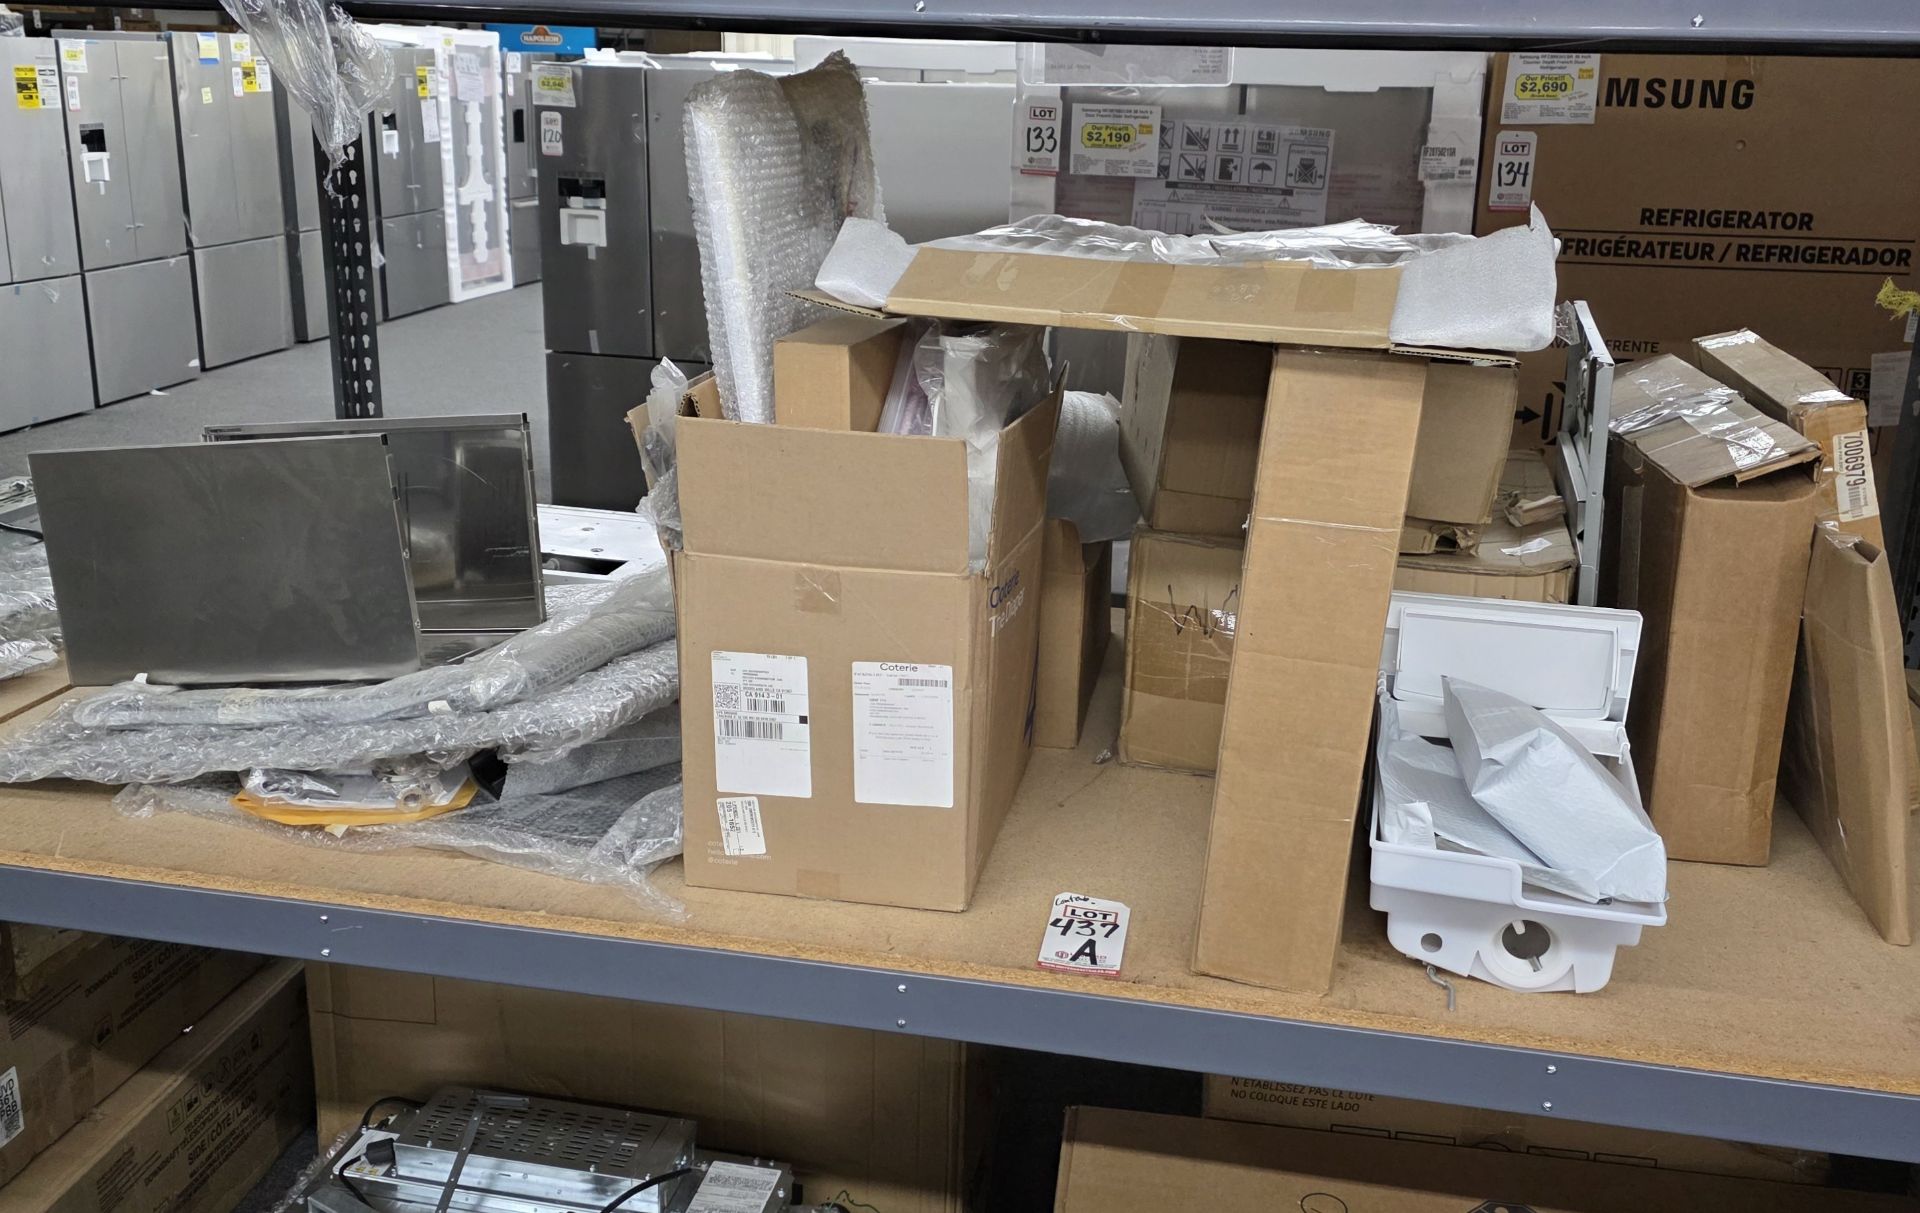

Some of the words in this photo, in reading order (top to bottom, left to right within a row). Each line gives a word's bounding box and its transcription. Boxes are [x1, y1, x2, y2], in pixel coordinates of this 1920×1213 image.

[1520, 81, 1568, 94] $2,690
[1597, 77, 1755, 110] MSUNG
[1033, 109, 1054, 118] LOT
[543, 129, 562, 143] 120
[1026, 126, 1058, 153] 133
[1086, 131, 1131, 143] $2,190
[1504, 144, 1527, 153] LOT
[1497, 161, 1530, 188] 134
[1640, 207, 1814, 231] REFRIGERATOR
[1555, 232, 1715, 262] FRIGÉRATEUR
[1736, 243, 1912, 268] REFRIGERADOR
[1854, 374, 1867, 389] 3
[1843, 431, 1867, 487] 7006979
[880, 662, 918, 672] Coterie
[1070, 908, 1112, 920] LOT
[1049, 918, 1120, 938] 437
[1068, 938, 1098, 966] A
[1230, 1089, 1246, 1099] NO
[1249, 1090, 1299, 1106] COLOQUE
[1302, 1097, 1328, 1109] ESTE
[1331, 1100, 1360, 1112] LADO
[187, 1138, 208, 1166] SIDE
